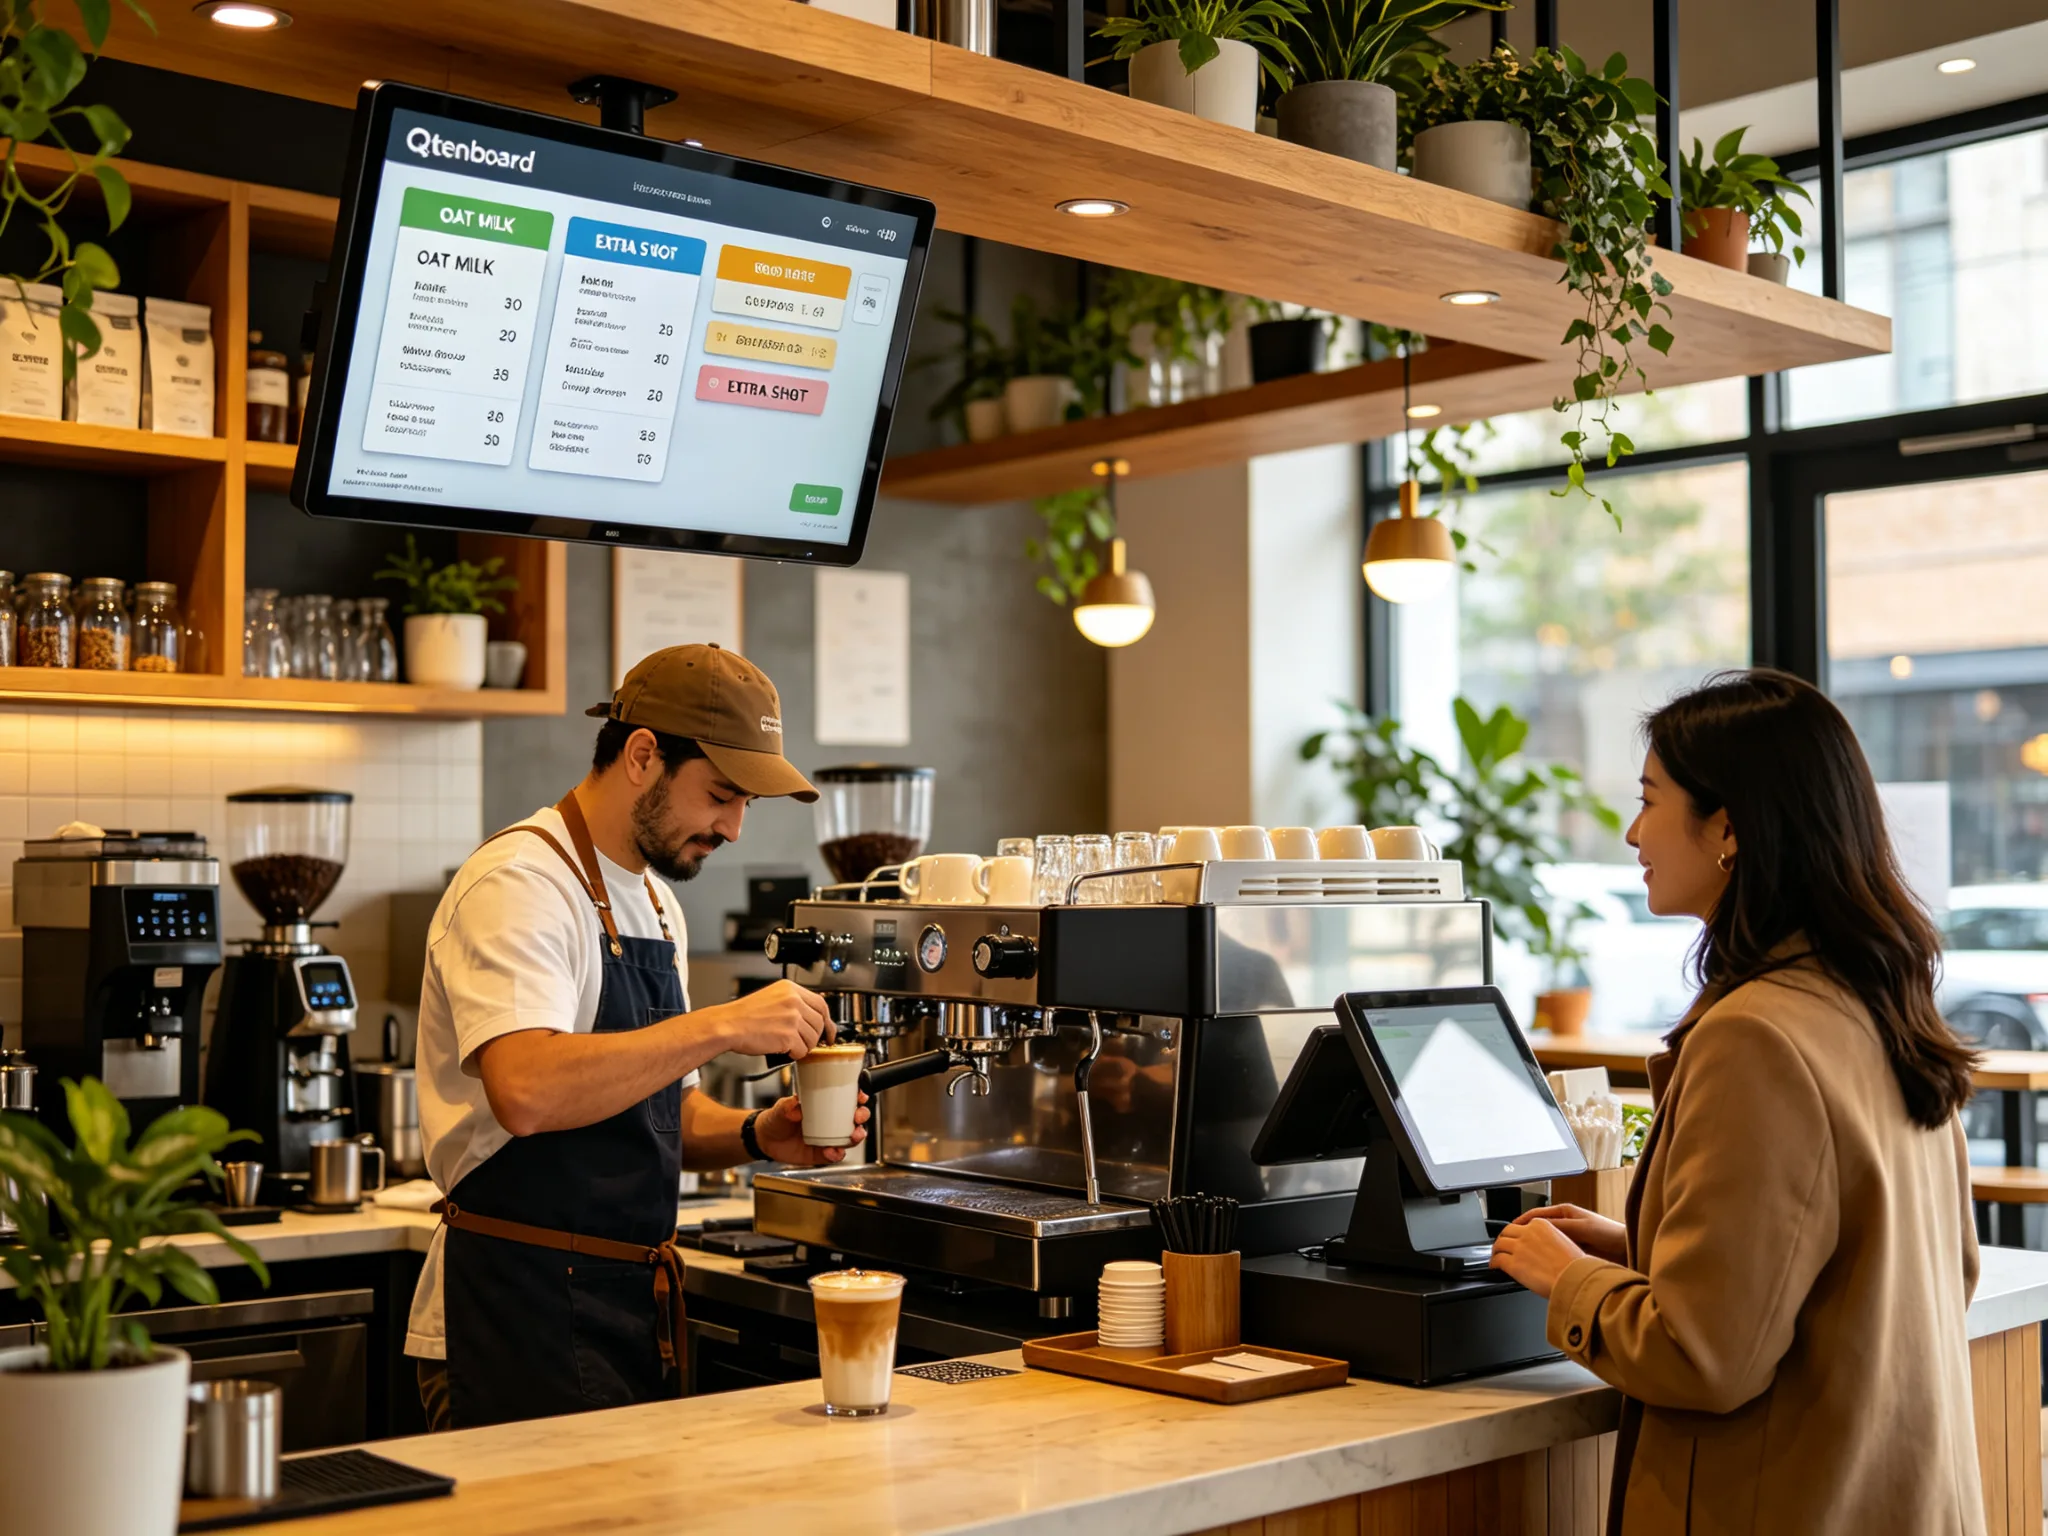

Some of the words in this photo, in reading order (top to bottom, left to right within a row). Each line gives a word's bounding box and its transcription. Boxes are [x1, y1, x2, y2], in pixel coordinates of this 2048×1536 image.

[406, 127, 535, 173] Qtenboard
[440, 208, 475, 227] OAT
[417, 250, 451, 269] OAT
[454, 255, 496, 276] MILK
[504, 297, 523, 311] 30
[499, 329, 517, 343] 20
[727, 379, 767, 397] EXTRA
[771, 385, 809, 402] SHOT
